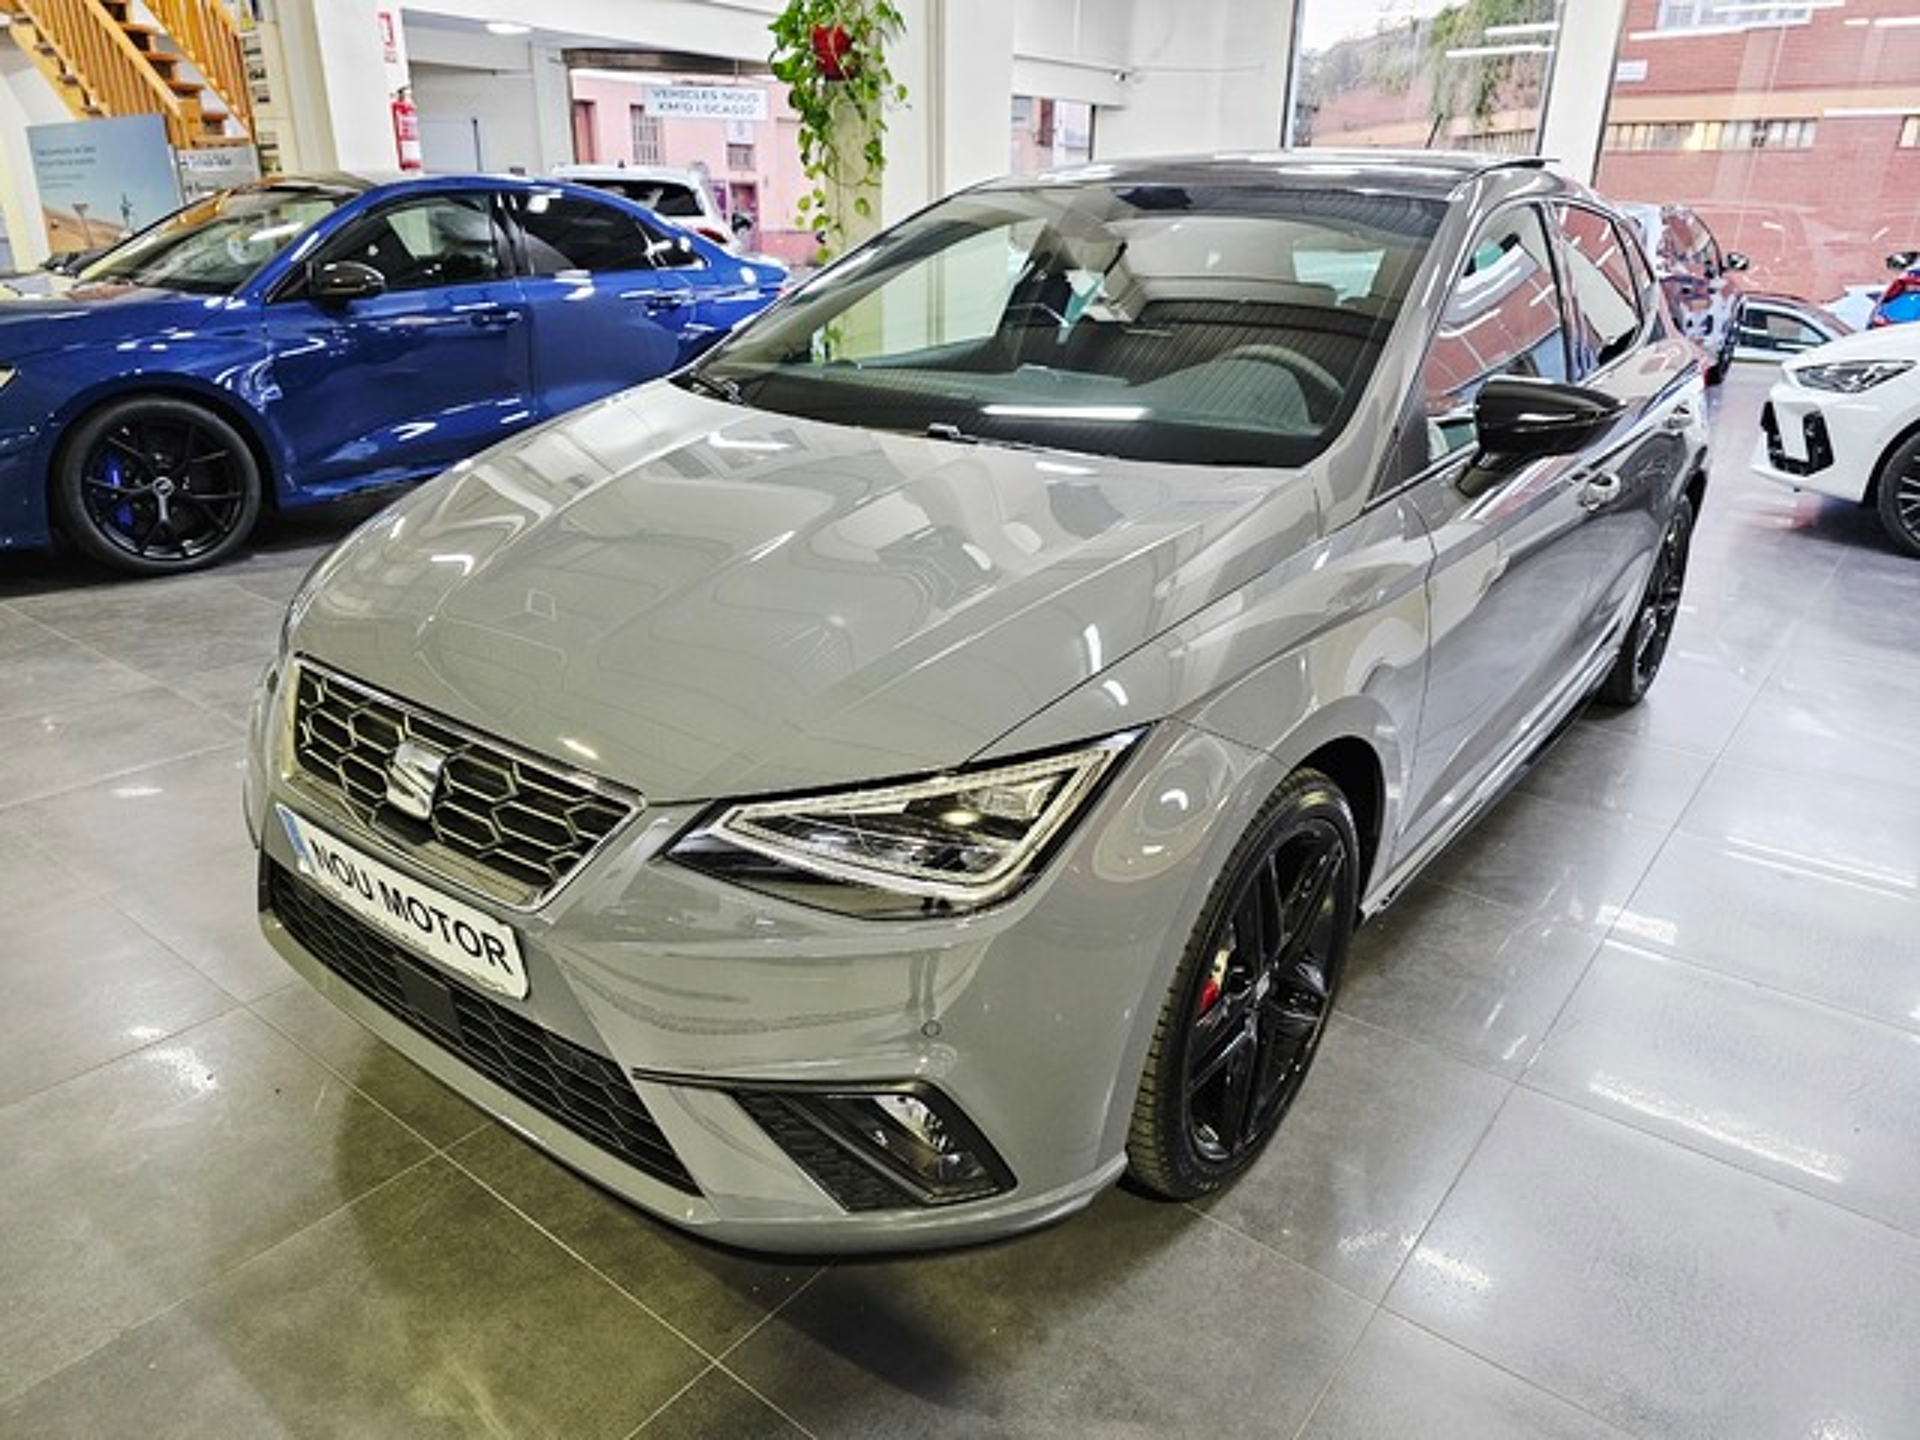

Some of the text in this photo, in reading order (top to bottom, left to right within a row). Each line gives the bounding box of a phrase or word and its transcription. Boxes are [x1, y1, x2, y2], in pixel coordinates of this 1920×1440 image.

[651, 90, 760, 103] VEHICLES NOUS
[310, 839, 373, 900] NOU
[378, 880, 513, 975] MOTOR
